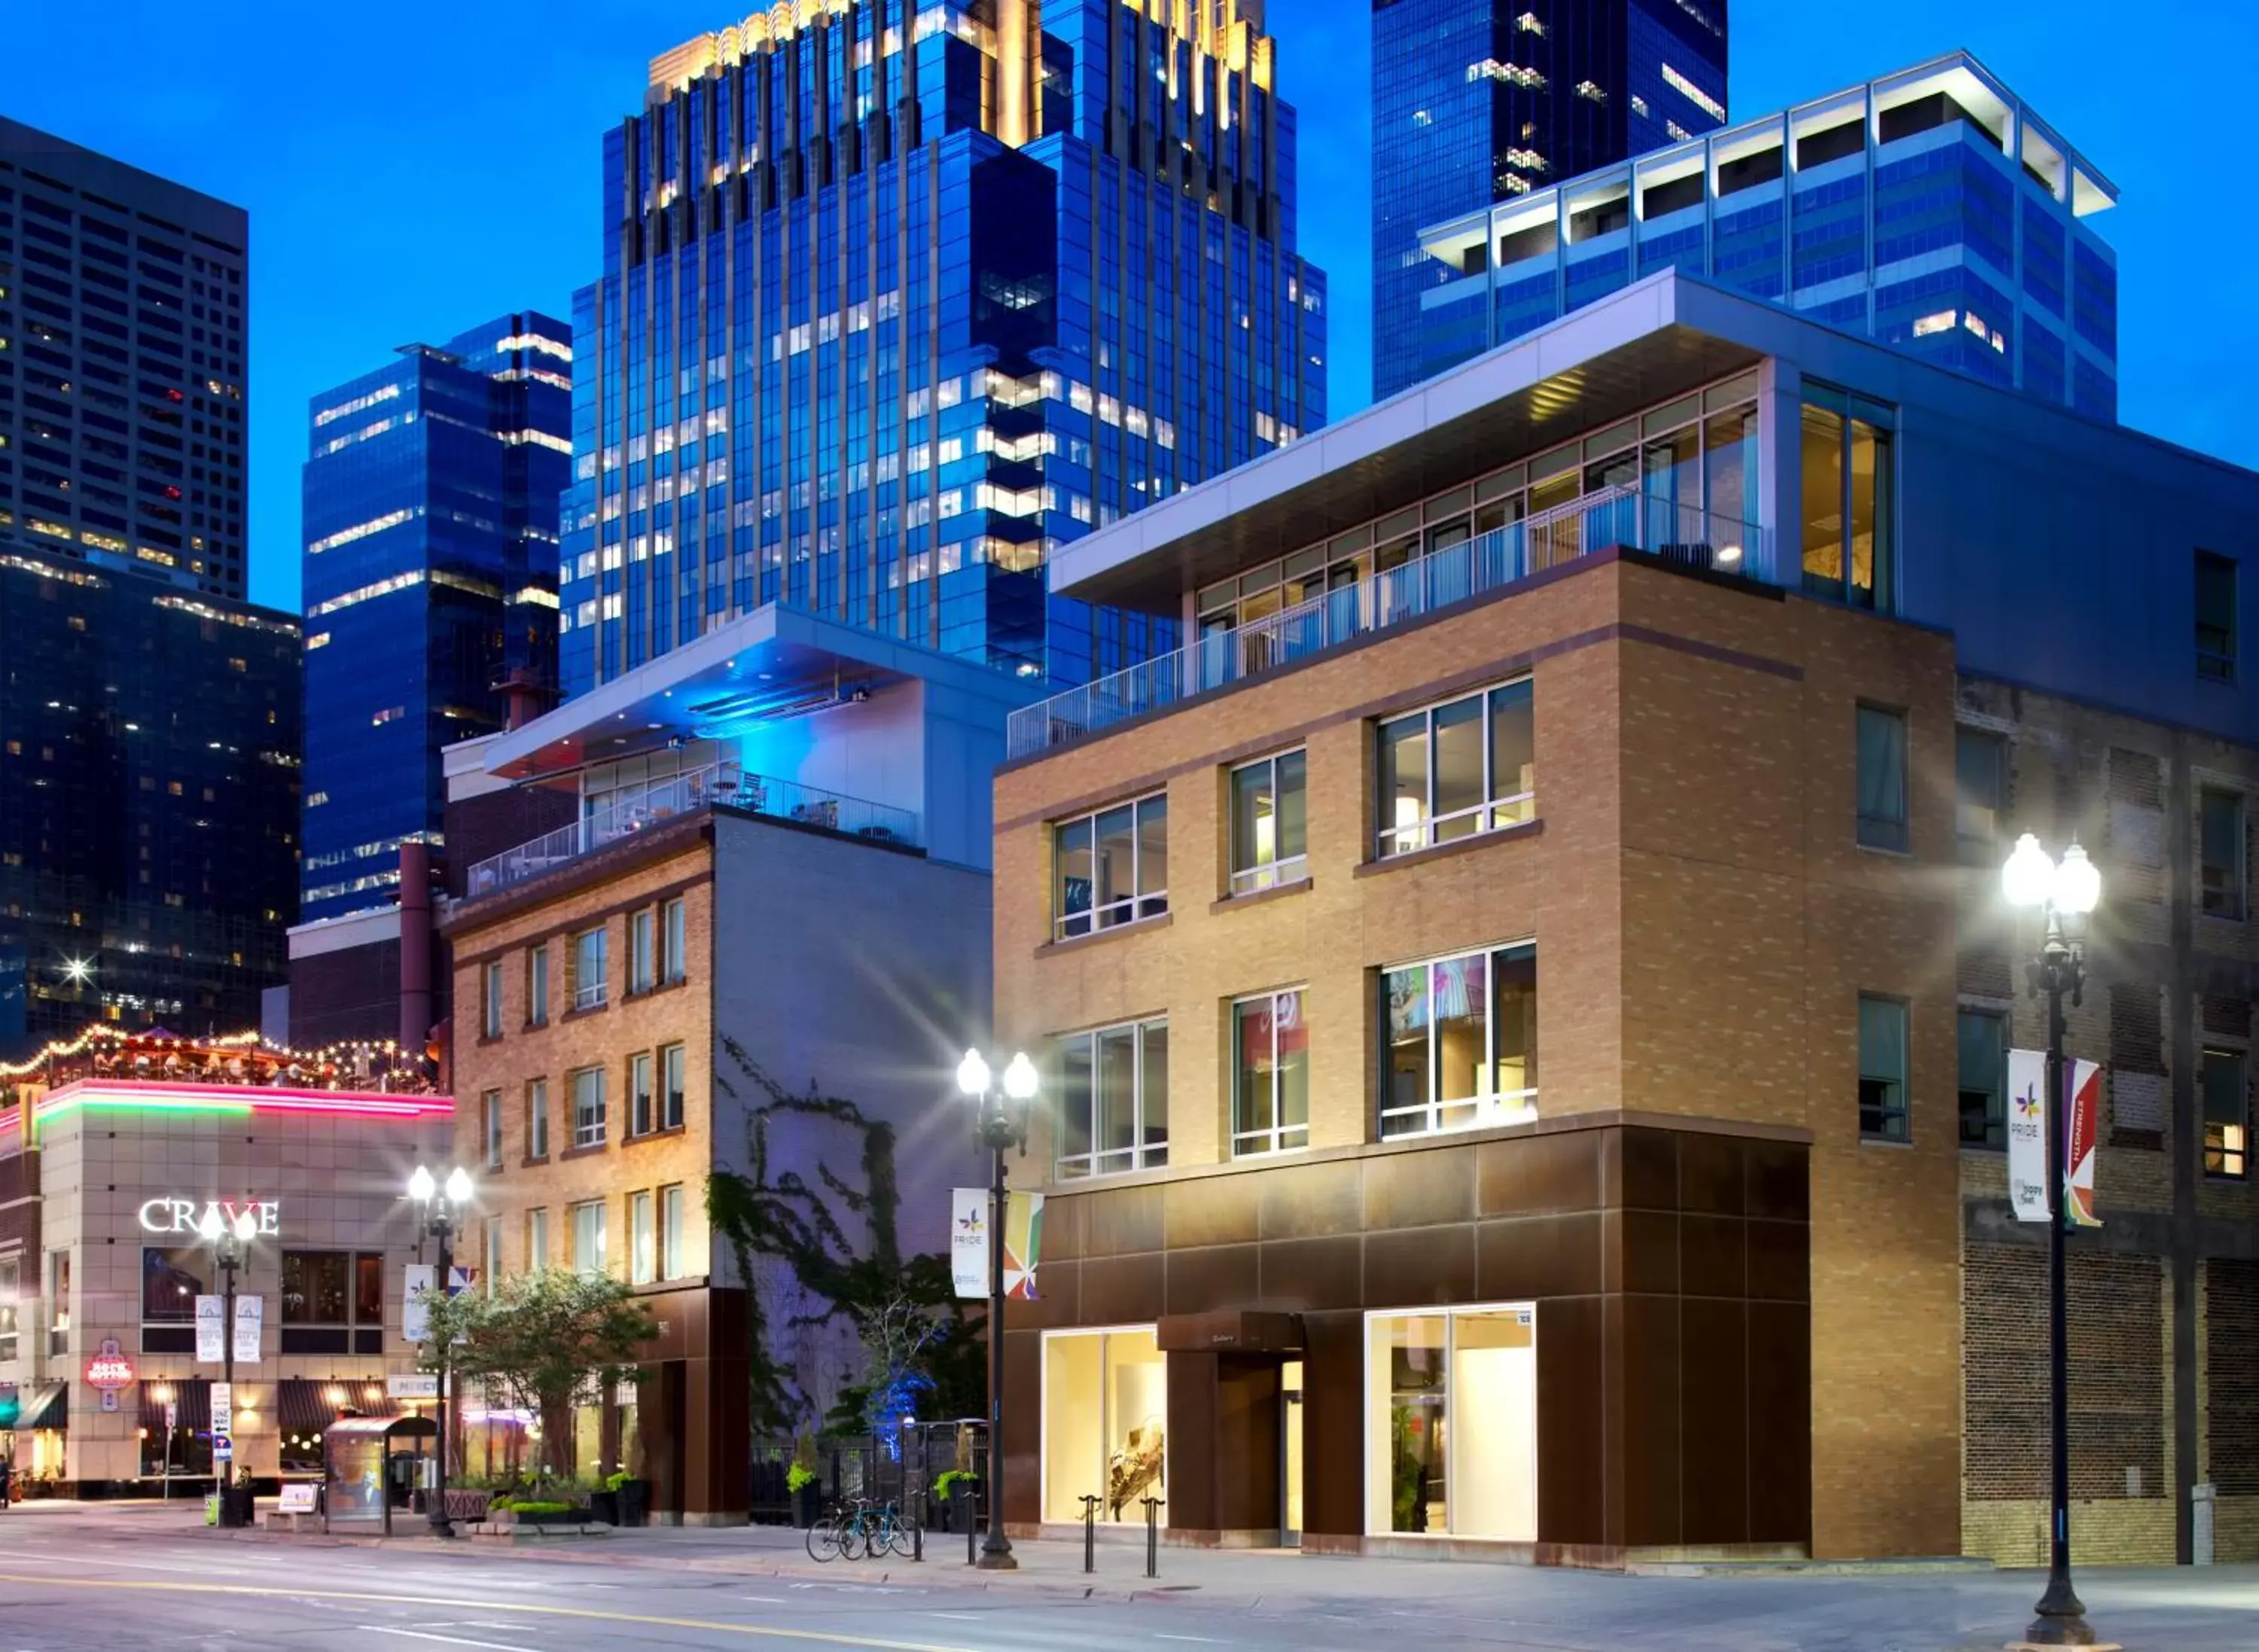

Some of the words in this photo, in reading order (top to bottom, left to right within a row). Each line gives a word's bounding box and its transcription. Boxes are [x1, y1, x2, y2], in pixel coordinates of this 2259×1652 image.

[2011, 1123, 2038, 1138] PRIDE
[139, 1196, 279, 1236] CRAVE
[954, 1235, 983, 1245] PRIDE
